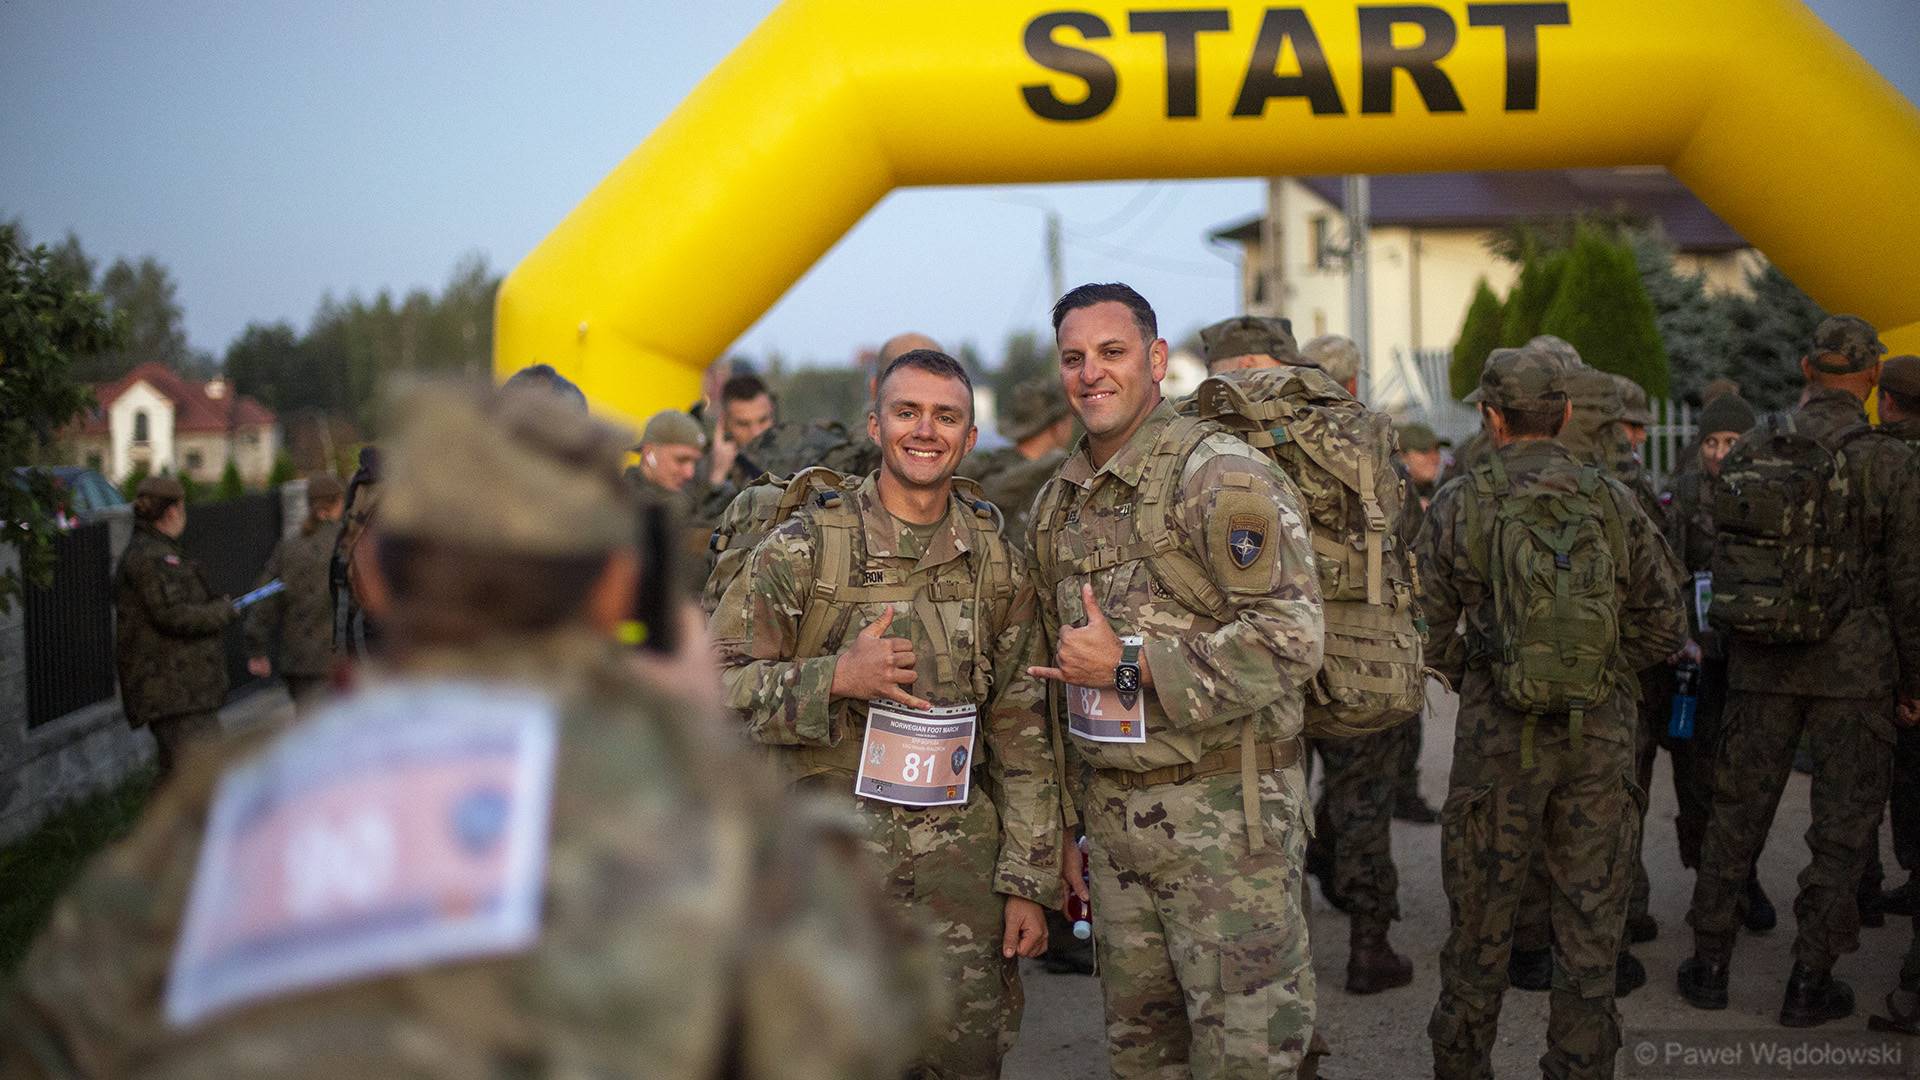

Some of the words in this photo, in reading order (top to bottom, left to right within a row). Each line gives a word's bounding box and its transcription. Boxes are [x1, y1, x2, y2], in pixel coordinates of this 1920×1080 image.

[1020, 2, 1571, 121] START
[863, 571, 884, 583] RON
[1080, 687, 1103, 716] 82
[890, 721, 926, 732] NORWEGIAN
[902, 752, 936, 784] 81
